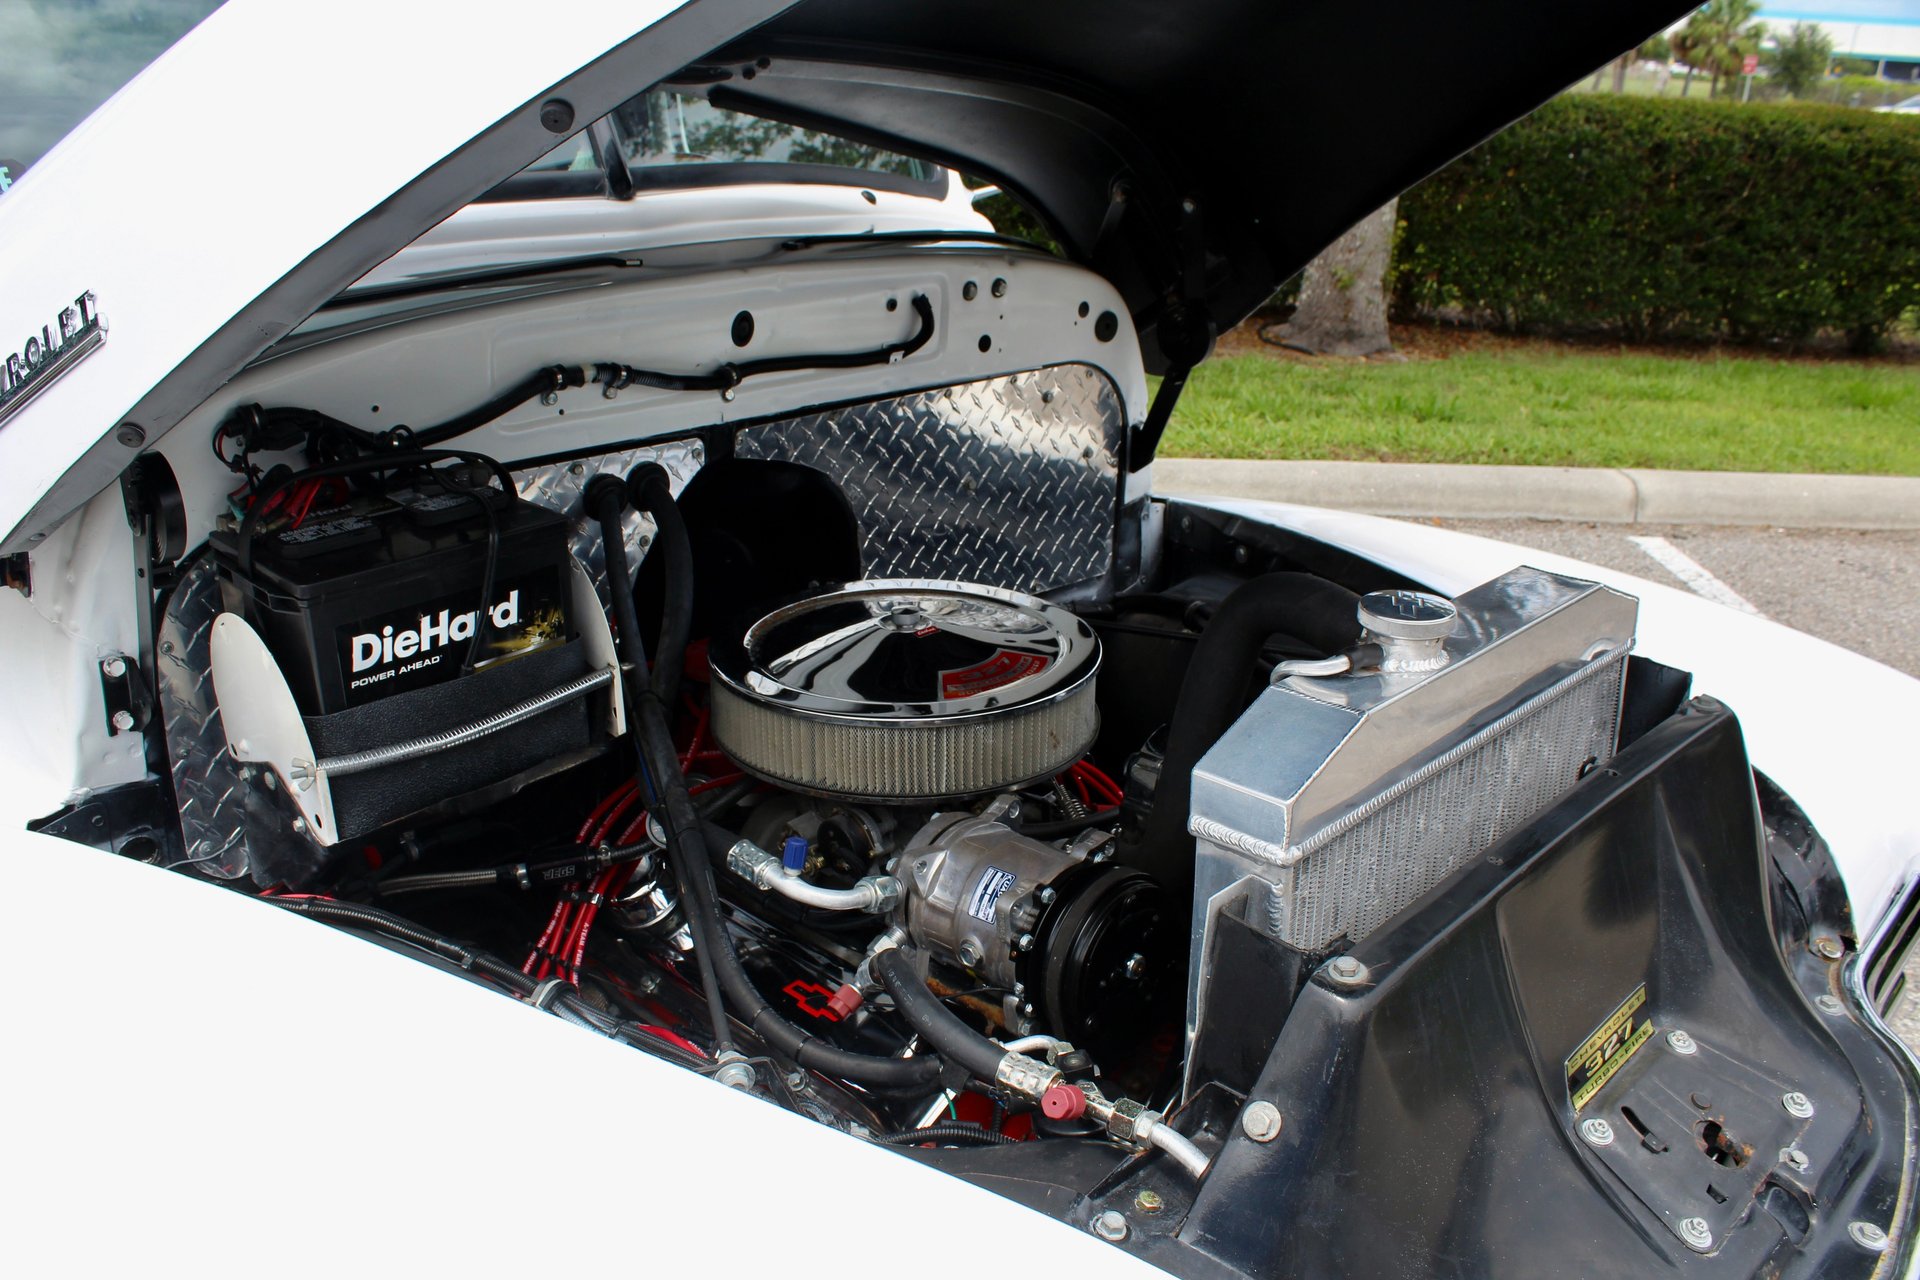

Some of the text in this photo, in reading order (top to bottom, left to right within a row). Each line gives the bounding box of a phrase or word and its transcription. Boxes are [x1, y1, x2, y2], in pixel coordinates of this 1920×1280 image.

[352, 589, 519, 673] DieHad
[351, 656, 440, 689] POWER AHEAD
[542, 864, 576, 881] JEGS
[1570, 994, 1642, 1069] CHEVROLET
[1577, 1027, 1650, 1101] TURBO-FIRE
[1585, 1017, 1634, 1078] 327
